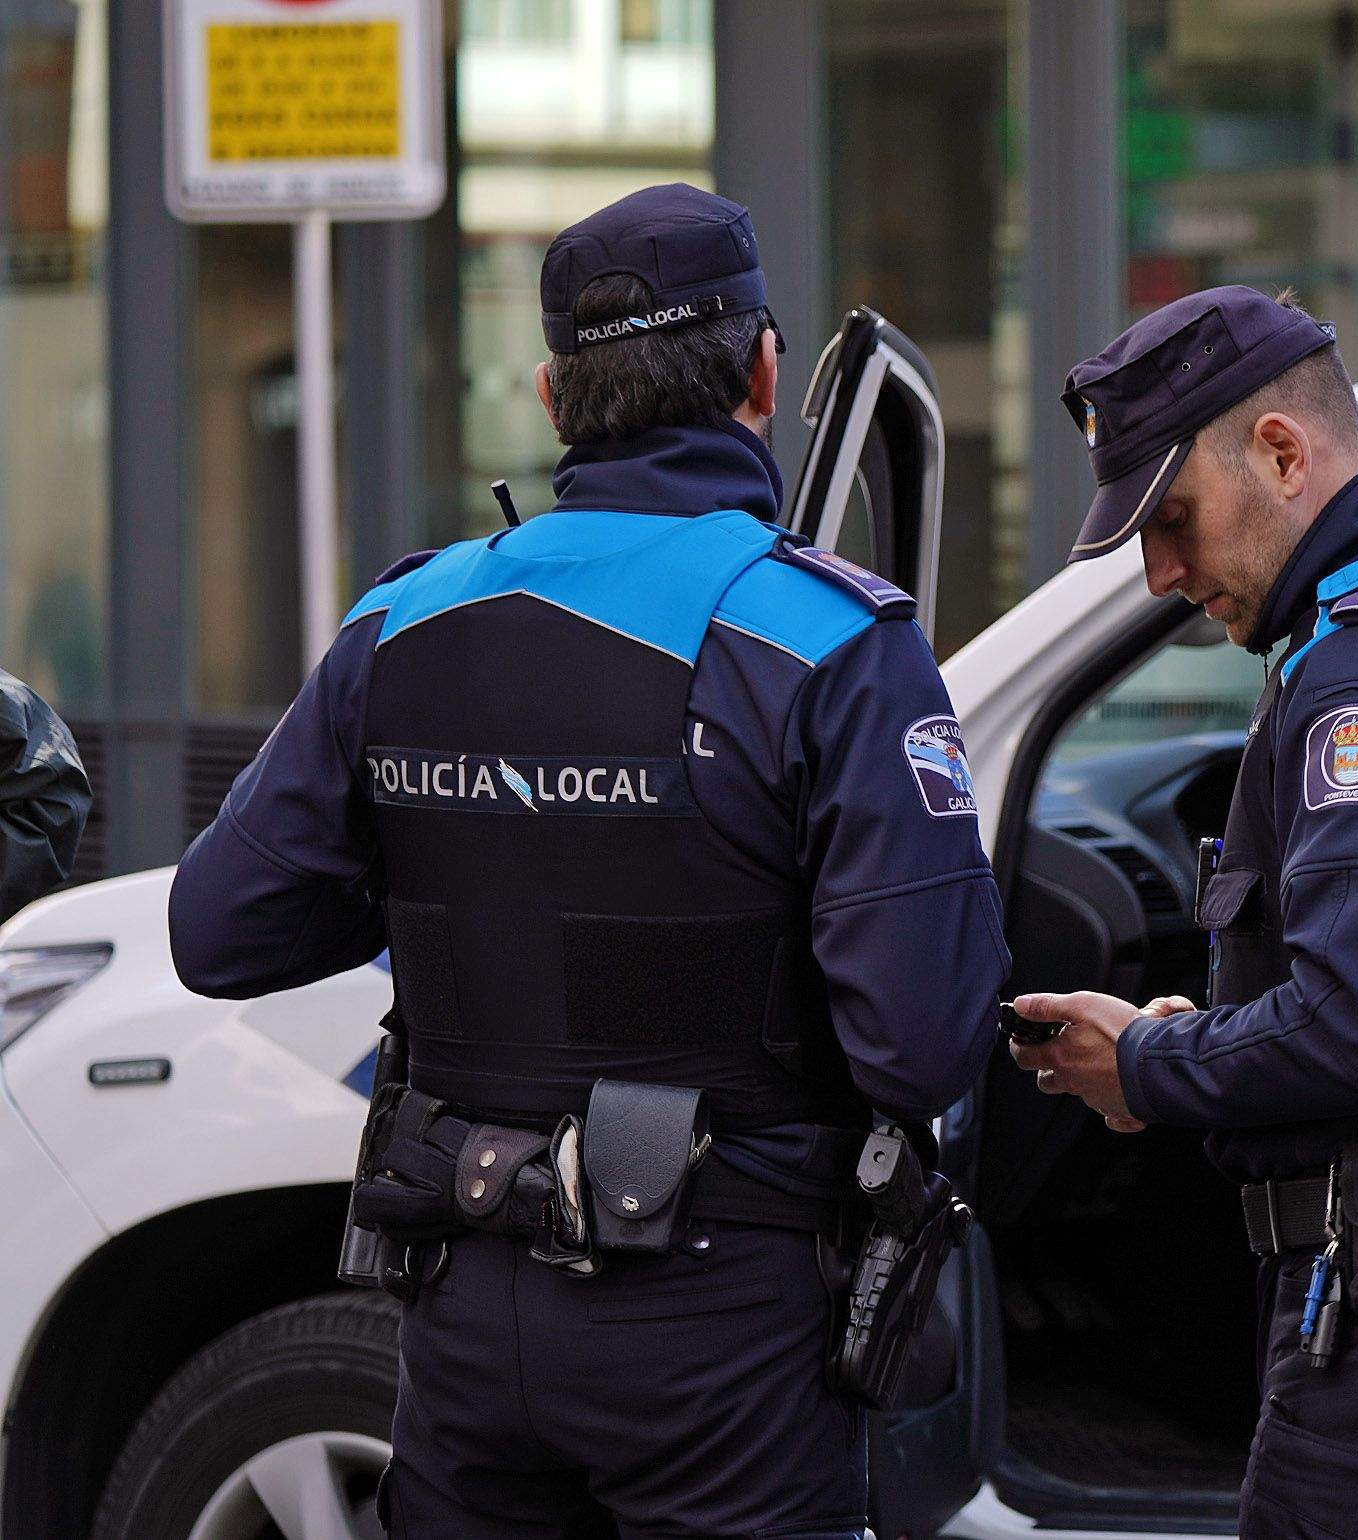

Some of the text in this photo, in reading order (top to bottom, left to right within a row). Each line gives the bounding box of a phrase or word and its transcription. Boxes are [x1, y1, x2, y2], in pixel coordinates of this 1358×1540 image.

[577, 304, 697, 342] POLICÍA LOCAL
[537, 766, 659, 804] LOCAL
